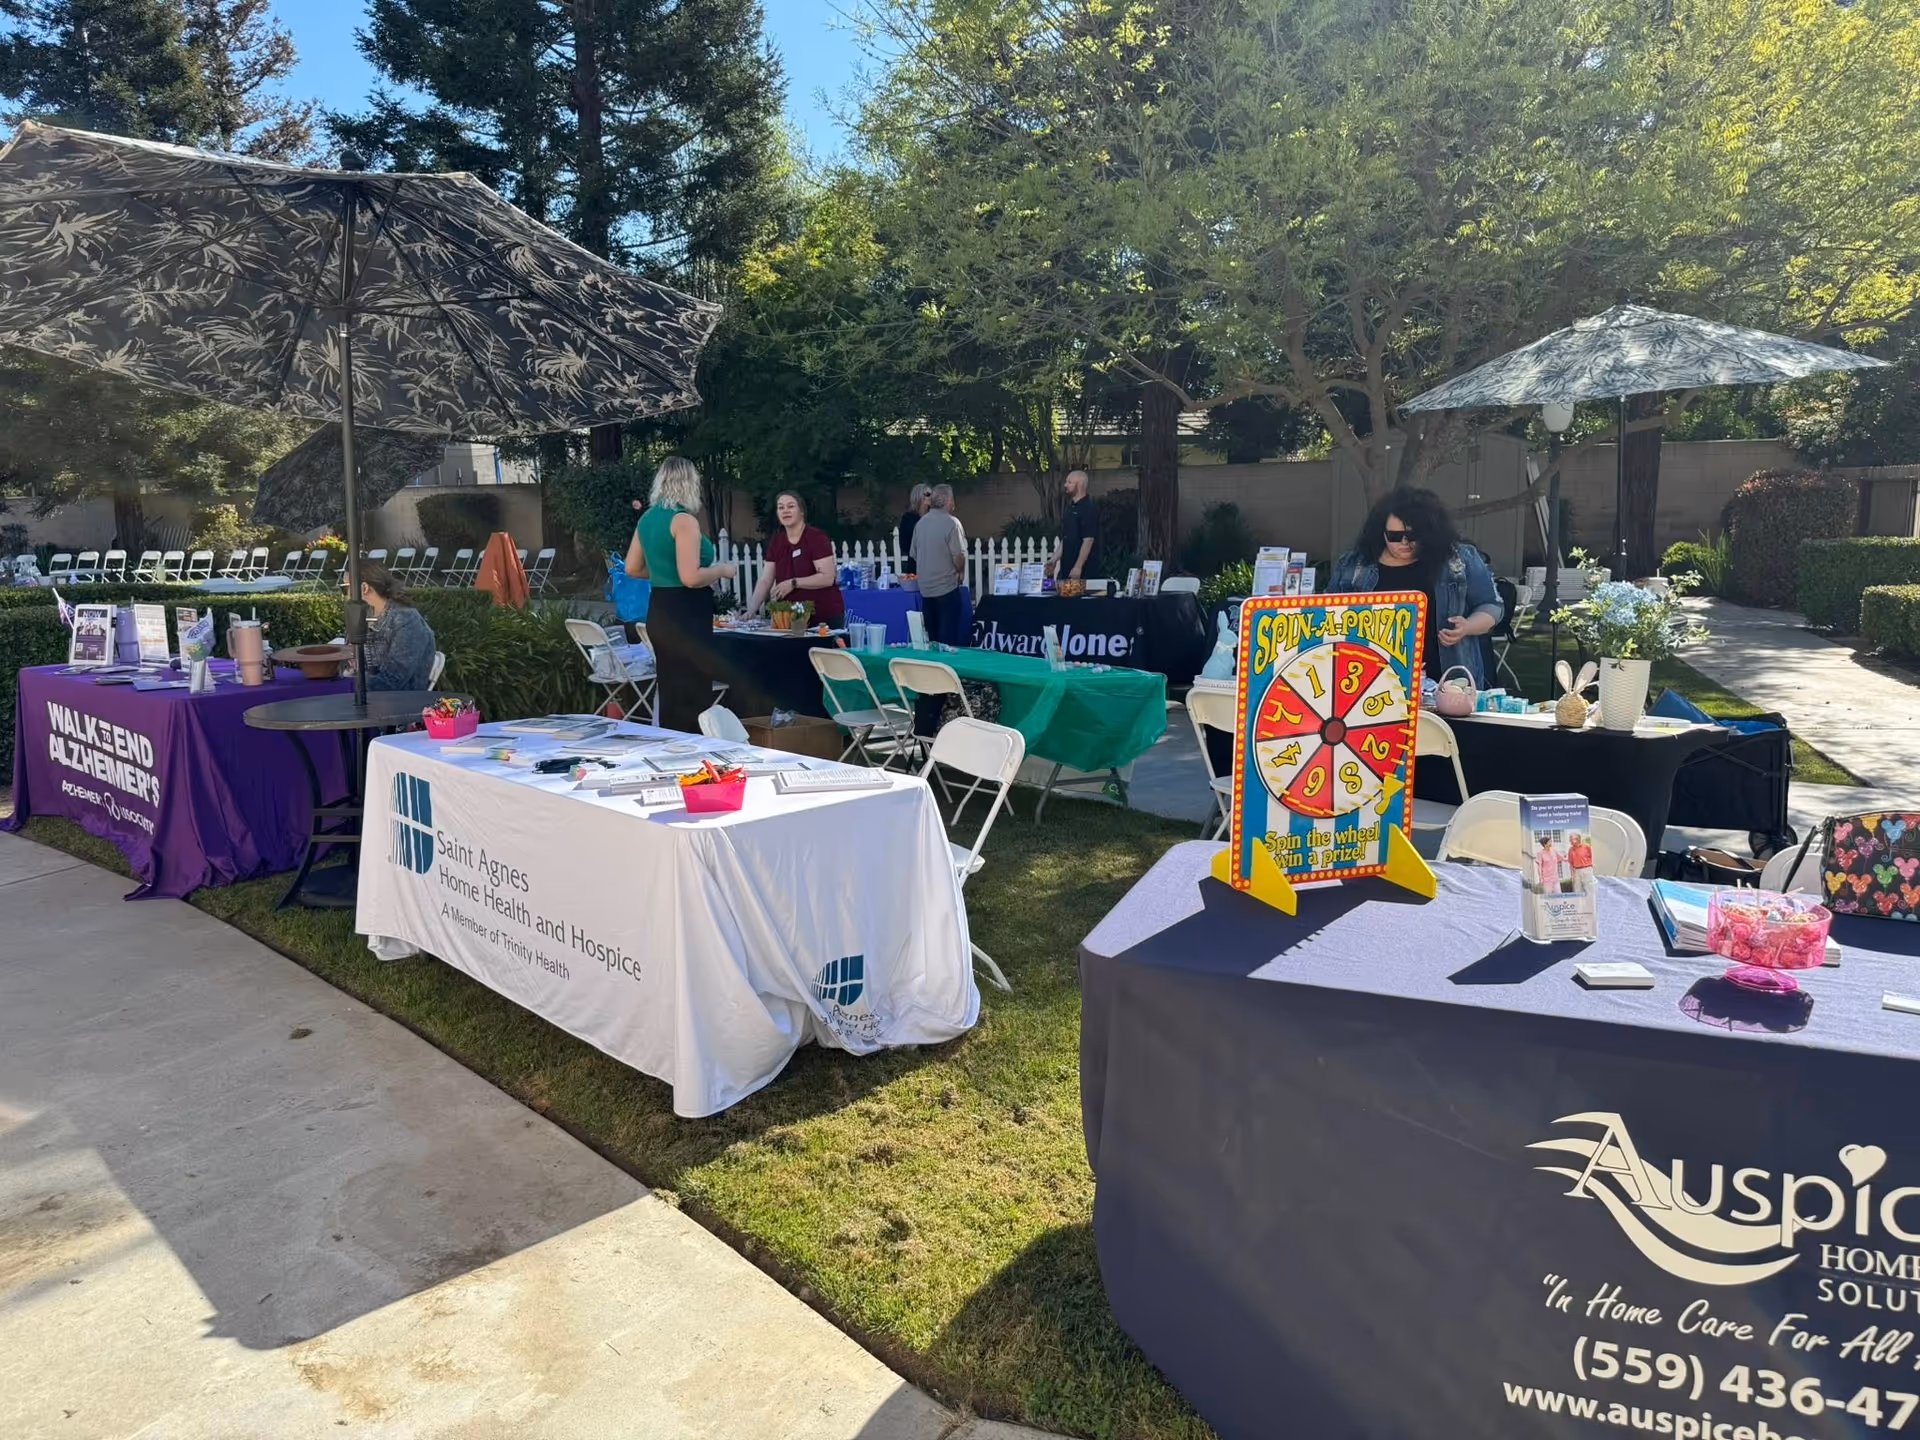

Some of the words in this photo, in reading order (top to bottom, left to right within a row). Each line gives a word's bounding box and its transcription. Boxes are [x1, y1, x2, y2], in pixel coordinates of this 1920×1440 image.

[82, 610, 102, 619] NOW
[1060, 624, 1134, 657] Jone
[1254, 608, 1411, 674] SPIN-A-PRIZE
[1306, 664, 1325, 698] 1
[1340, 661, 1363, 694] 3
[1271, 697, 1302, 725] 7
[1362, 691, 1393, 716] 5
[47, 700, 102, 748] WALK
[101, 730, 111, 743] TO
[112, 724, 154, 768] END
[1360, 733, 1391, 760] 2
[49, 733, 160, 808] ALZHEIMER'S
[1271, 741, 1302, 767] 4
[1339, 761, 1363, 794] 8
[1265, 831, 1302, 853] Spin
[1306, 827, 1331, 848] the
[1335, 820, 1380, 845] wheel
[436, 830, 474, 869] Saint
[478, 849, 529, 893] Agnes
[1273, 849, 1303, 868] win
[1308, 851, 1318, 866] a
[1321, 841, 1366, 868] prize!
[439, 864, 480, 902] Home
[484, 885, 531, 928] Health
[536, 914, 565, 944] and
[571, 925, 642, 982] Hospice
[441, 901, 450, 919] A
[451, 906, 487, 938] Member
[489, 929, 500, 945] of
[501, 931, 533, 965] Trinity
[535, 949, 570, 981] Health
[1585, 1282, 1663, 1325] Home
[1677, 1299, 1754, 1340] Care
[1768, 1313, 1830, 1352] For
[1839, 1325, 1915, 1364] All
[1573, 1336, 1704, 1401] (559)
[1719, 1364, 1920, 1431] 436-47
[1503, 1382, 1815, 1440] www.auspiceh
